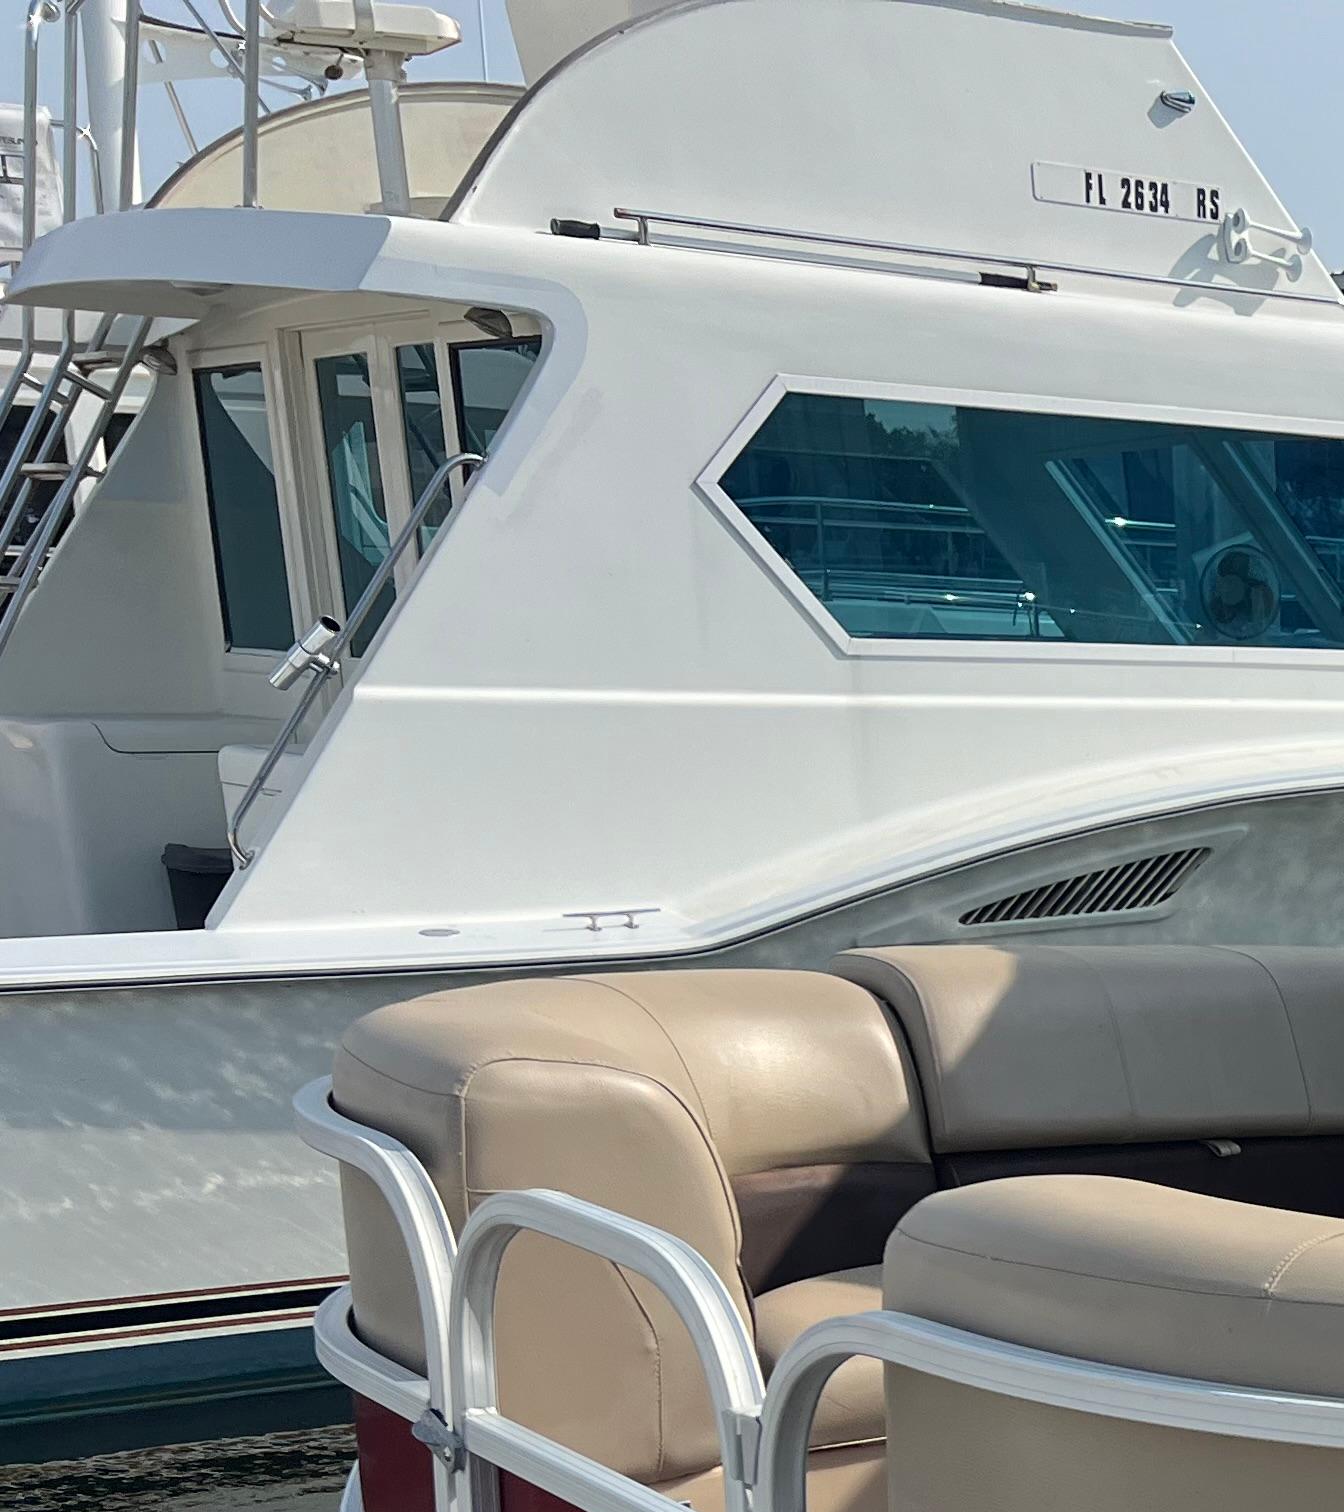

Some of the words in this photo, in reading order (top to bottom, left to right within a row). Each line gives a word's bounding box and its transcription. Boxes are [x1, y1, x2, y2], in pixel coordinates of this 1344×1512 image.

[1084, 172, 1106, 206] FL
[1120, 178, 1170, 214] 2634
[1196, 188, 1220, 220] RS
